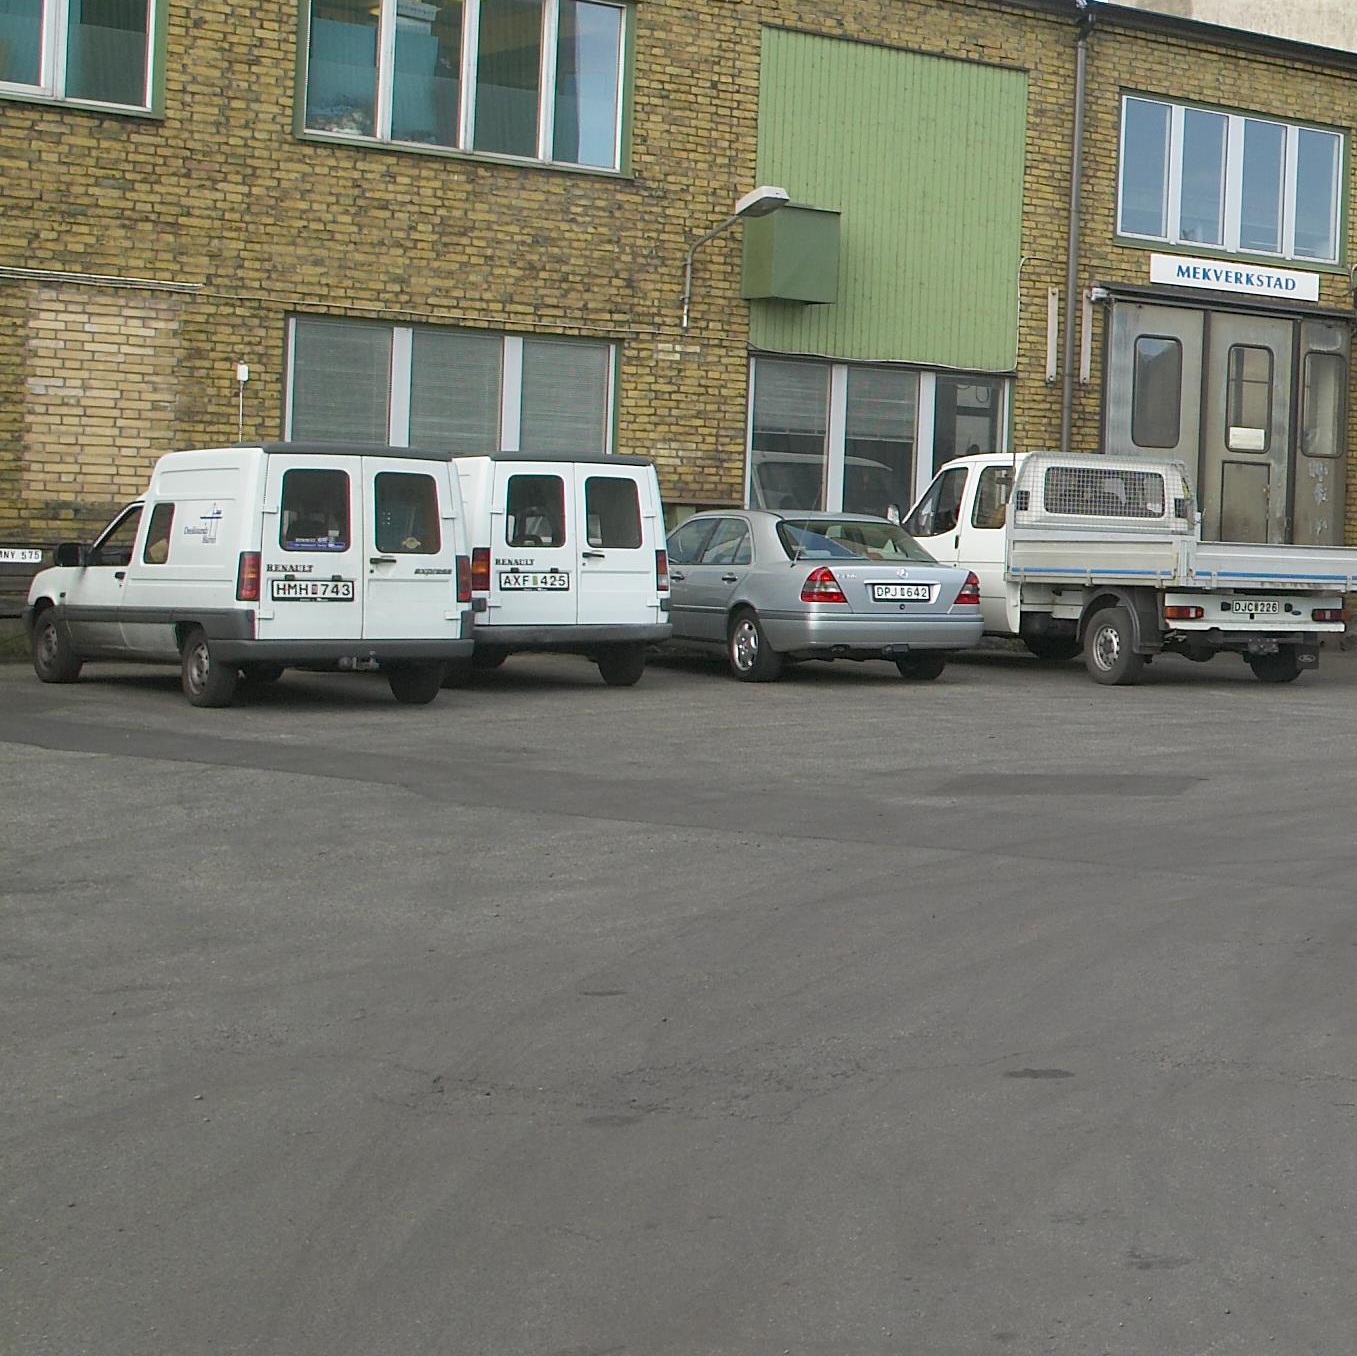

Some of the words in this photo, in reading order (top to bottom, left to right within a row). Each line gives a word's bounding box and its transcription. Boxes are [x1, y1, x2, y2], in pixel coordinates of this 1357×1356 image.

[1176, 264, 1297, 291] MEKVERKSTAD
[0, 550, 16, 560] NY
[21, 550, 40, 561] 575
[495, 558, 535, 566] RENAULT
[266, 563, 314, 573] RENAULT
[503, 575, 529, 586] AXF
[540, 575, 566, 586] 425
[276, 584, 309, 596] HMH
[320, 583, 351, 596] 743
[876, 586, 897, 597] DPJ
[906, 587, 927, 598] 642
[1234, 602, 1254, 612] DJC
